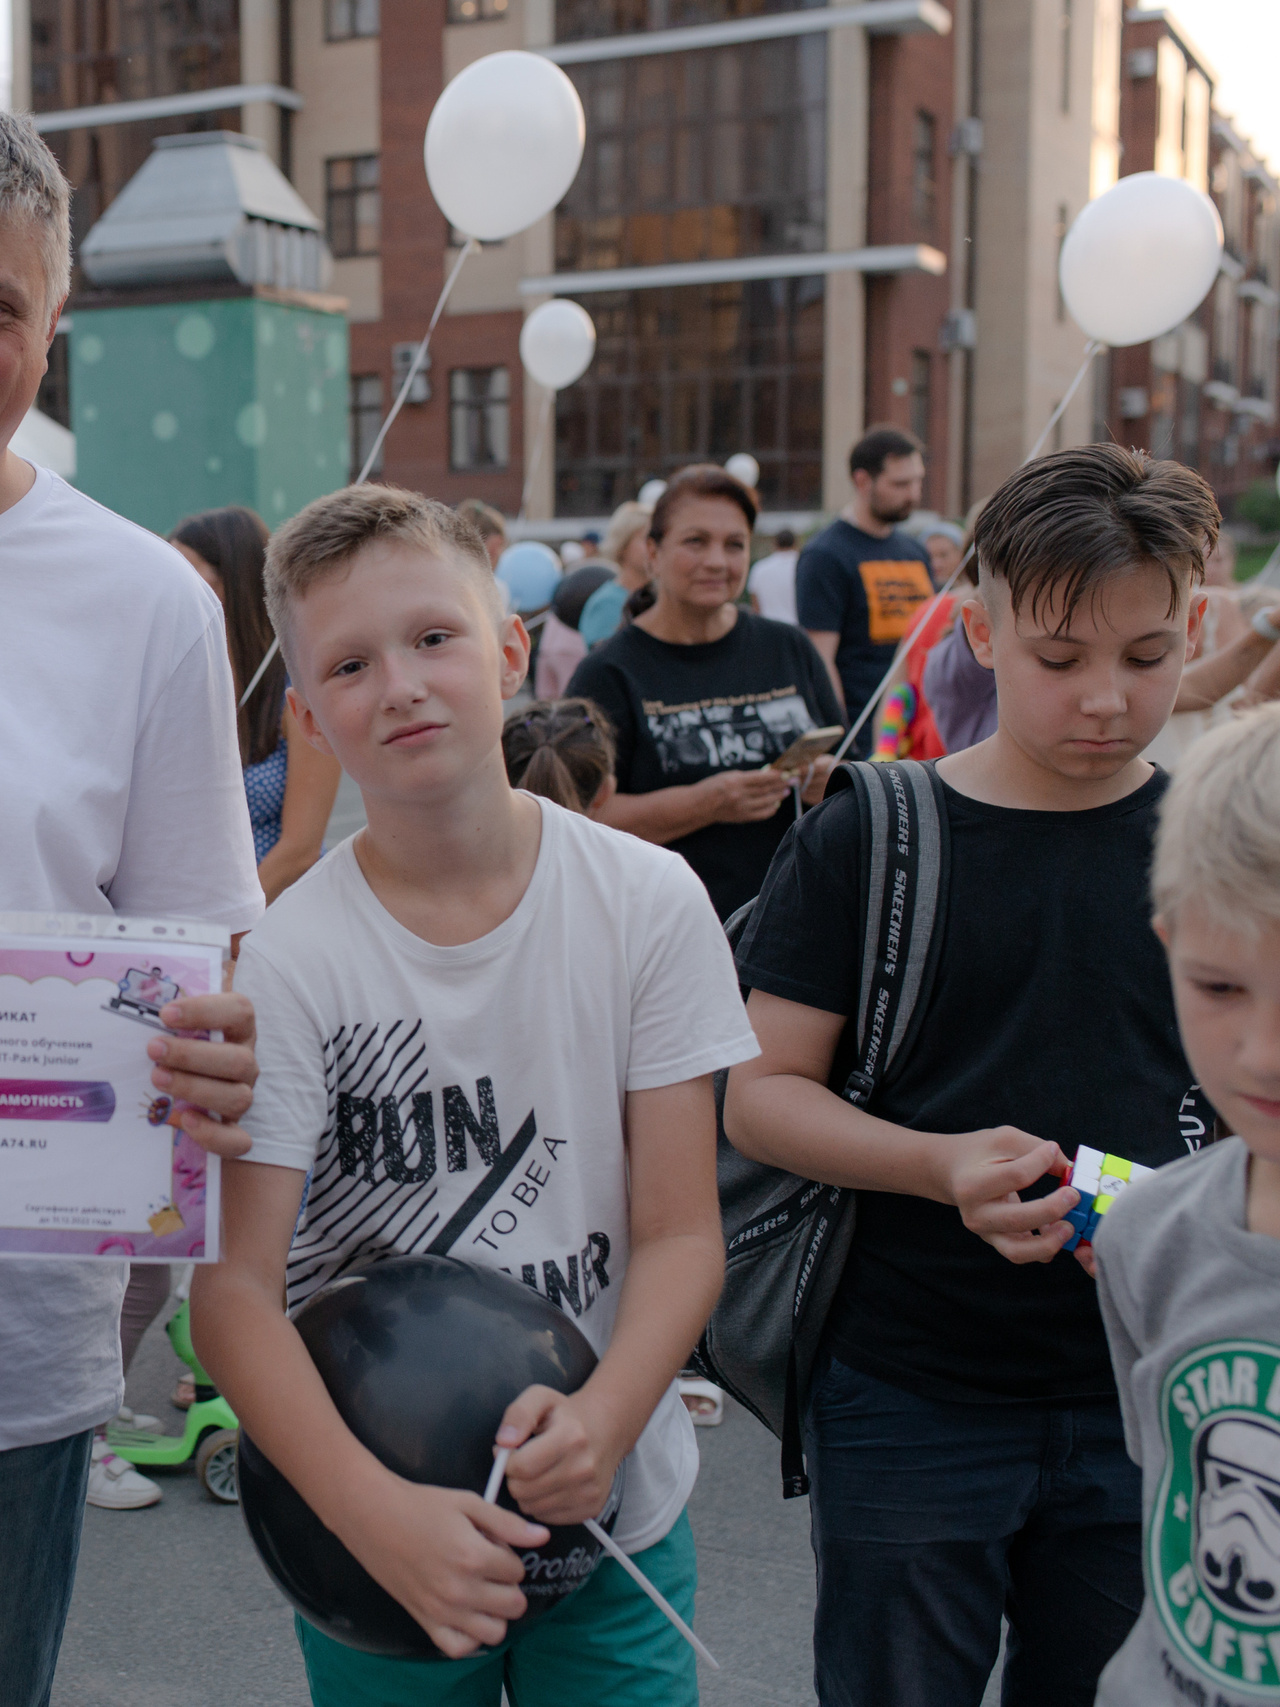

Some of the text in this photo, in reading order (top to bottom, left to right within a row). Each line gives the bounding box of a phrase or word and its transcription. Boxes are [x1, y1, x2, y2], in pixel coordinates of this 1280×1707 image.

[885, 768, 910, 856] SKECHERS
[884, 868, 908, 977] SKECHERS
[31, 1037, 93, 1051] обучения
[866, 987, 891, 1077] SKECHER
[336, 1075, 503, 1187] RUN
[472, 1136, 568, 1251] TO BE A
[728, 1210, 789, 1251] CHERS
[1171, 1356, 1259, 1431] STAR
